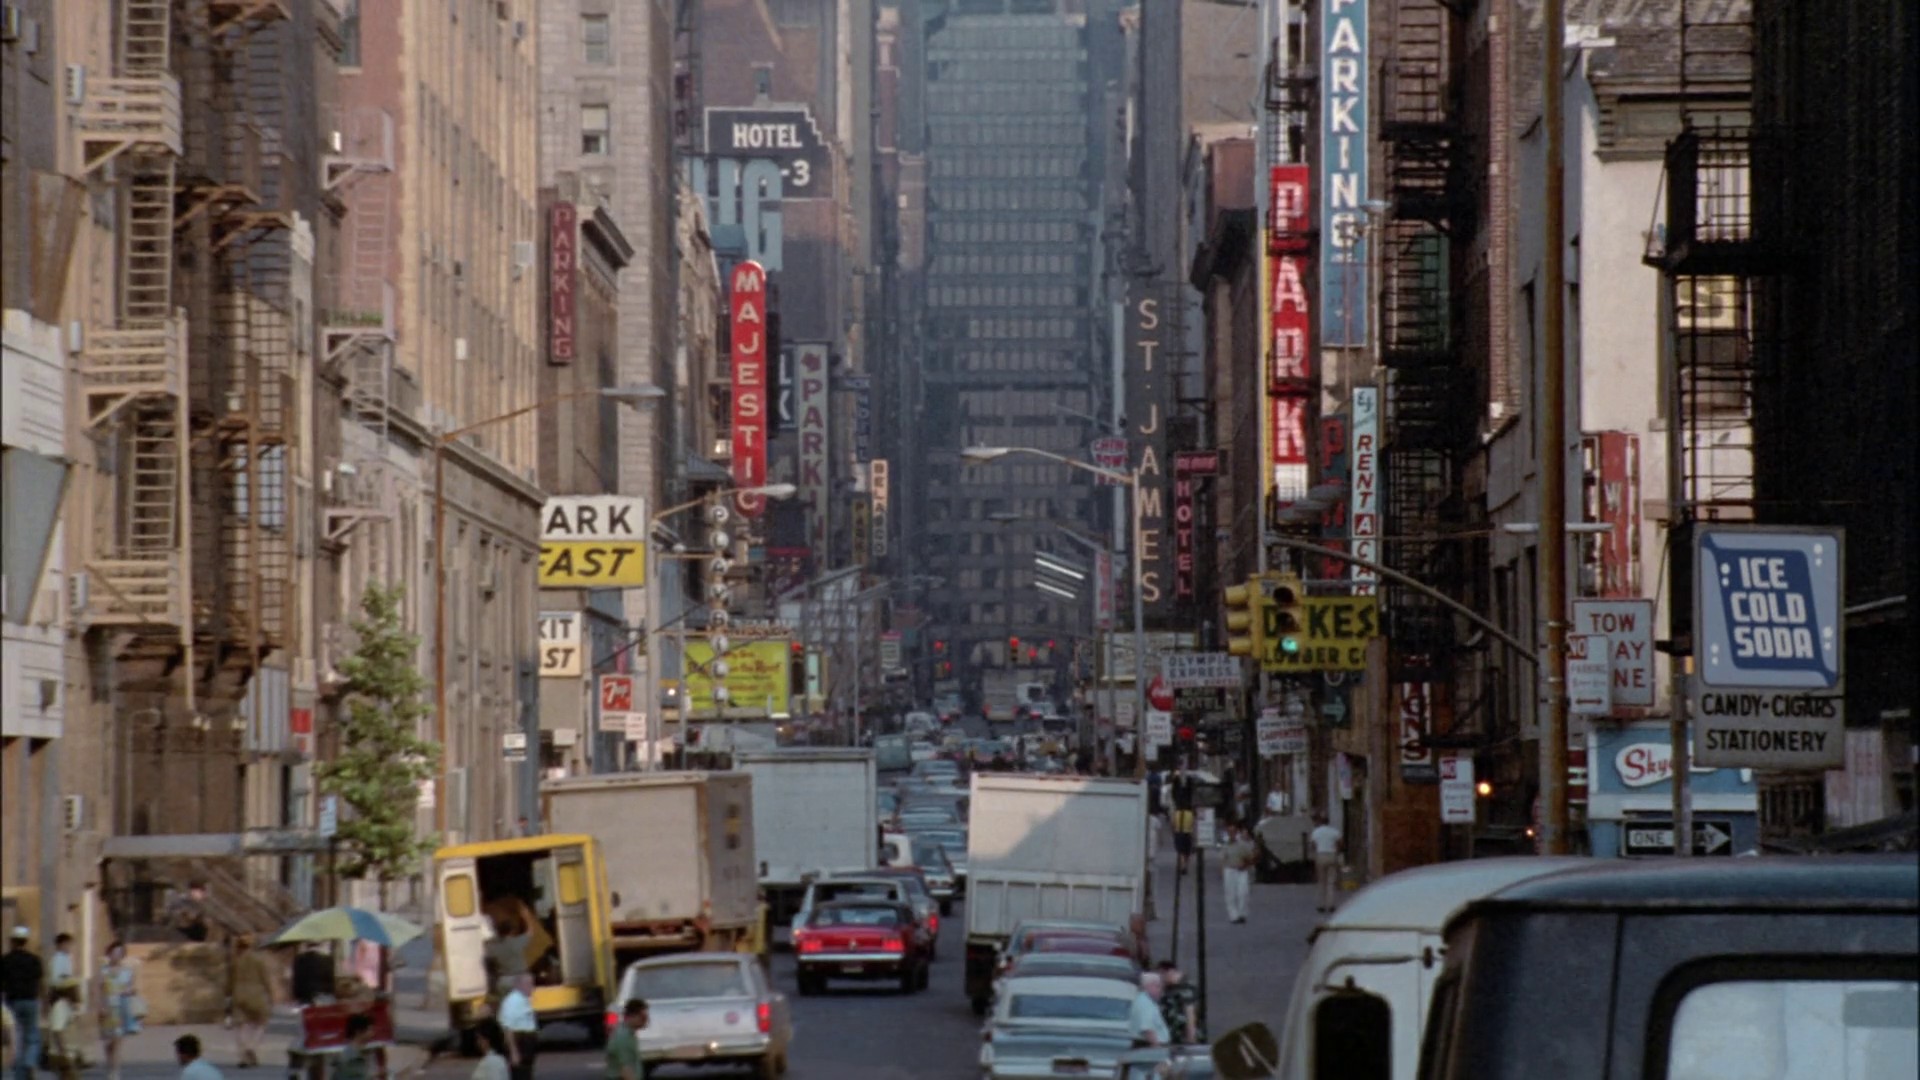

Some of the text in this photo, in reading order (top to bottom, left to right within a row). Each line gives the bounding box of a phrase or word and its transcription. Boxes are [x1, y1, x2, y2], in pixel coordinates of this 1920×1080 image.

[732, 123, 803, 148] HOTEL
[553, 208, 573, 358] PARKING
[1274, 182, 1308, 458] PARK
[735, 271, 761, 510] MAJESTIC
[1357, 434, 1374, 508] RENT
[546, 505, 632, 534] ARK
[1139, 404, 1162, 602] JAMES
[1177, 480, 1192, 595] HOTEL
[1739, 557, 1788, 589] ICE
[1263, 603, 1375, 639] DKES
[1590, 612, 1636, 633] TOW
[1730, 591, 1807, 624] COLD
[1734, 626, 1814, 659] SODA
[1706, 729, 1827, 752] STATIONERY
[1633, 832, 1665, 845] ONE
